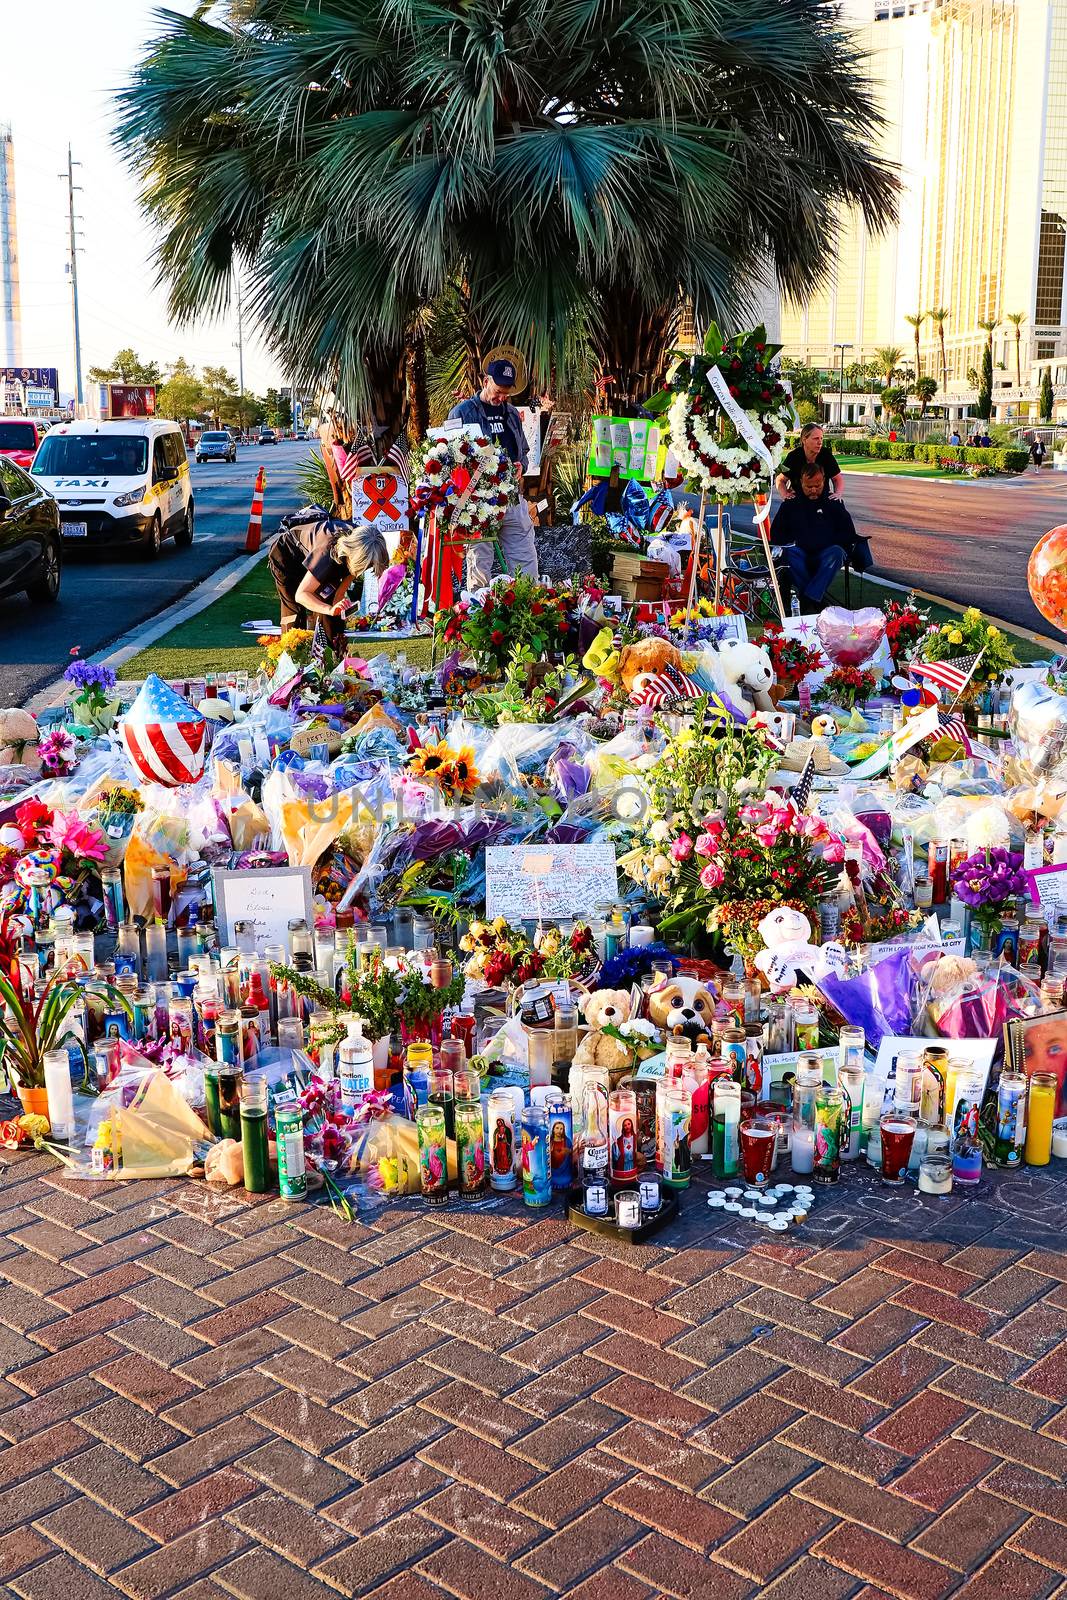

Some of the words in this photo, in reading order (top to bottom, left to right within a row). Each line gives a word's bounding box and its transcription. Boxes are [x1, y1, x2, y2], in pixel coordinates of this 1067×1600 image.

[21, 368, 37, 381] 91
[711, 376, 725, 401] Cypress
[724, 401, 738, 419] Police
[377, 479, 385, 488] 91
[306, 733, 323, 744] REST
[342, 1077, 369, 1091] WATER
